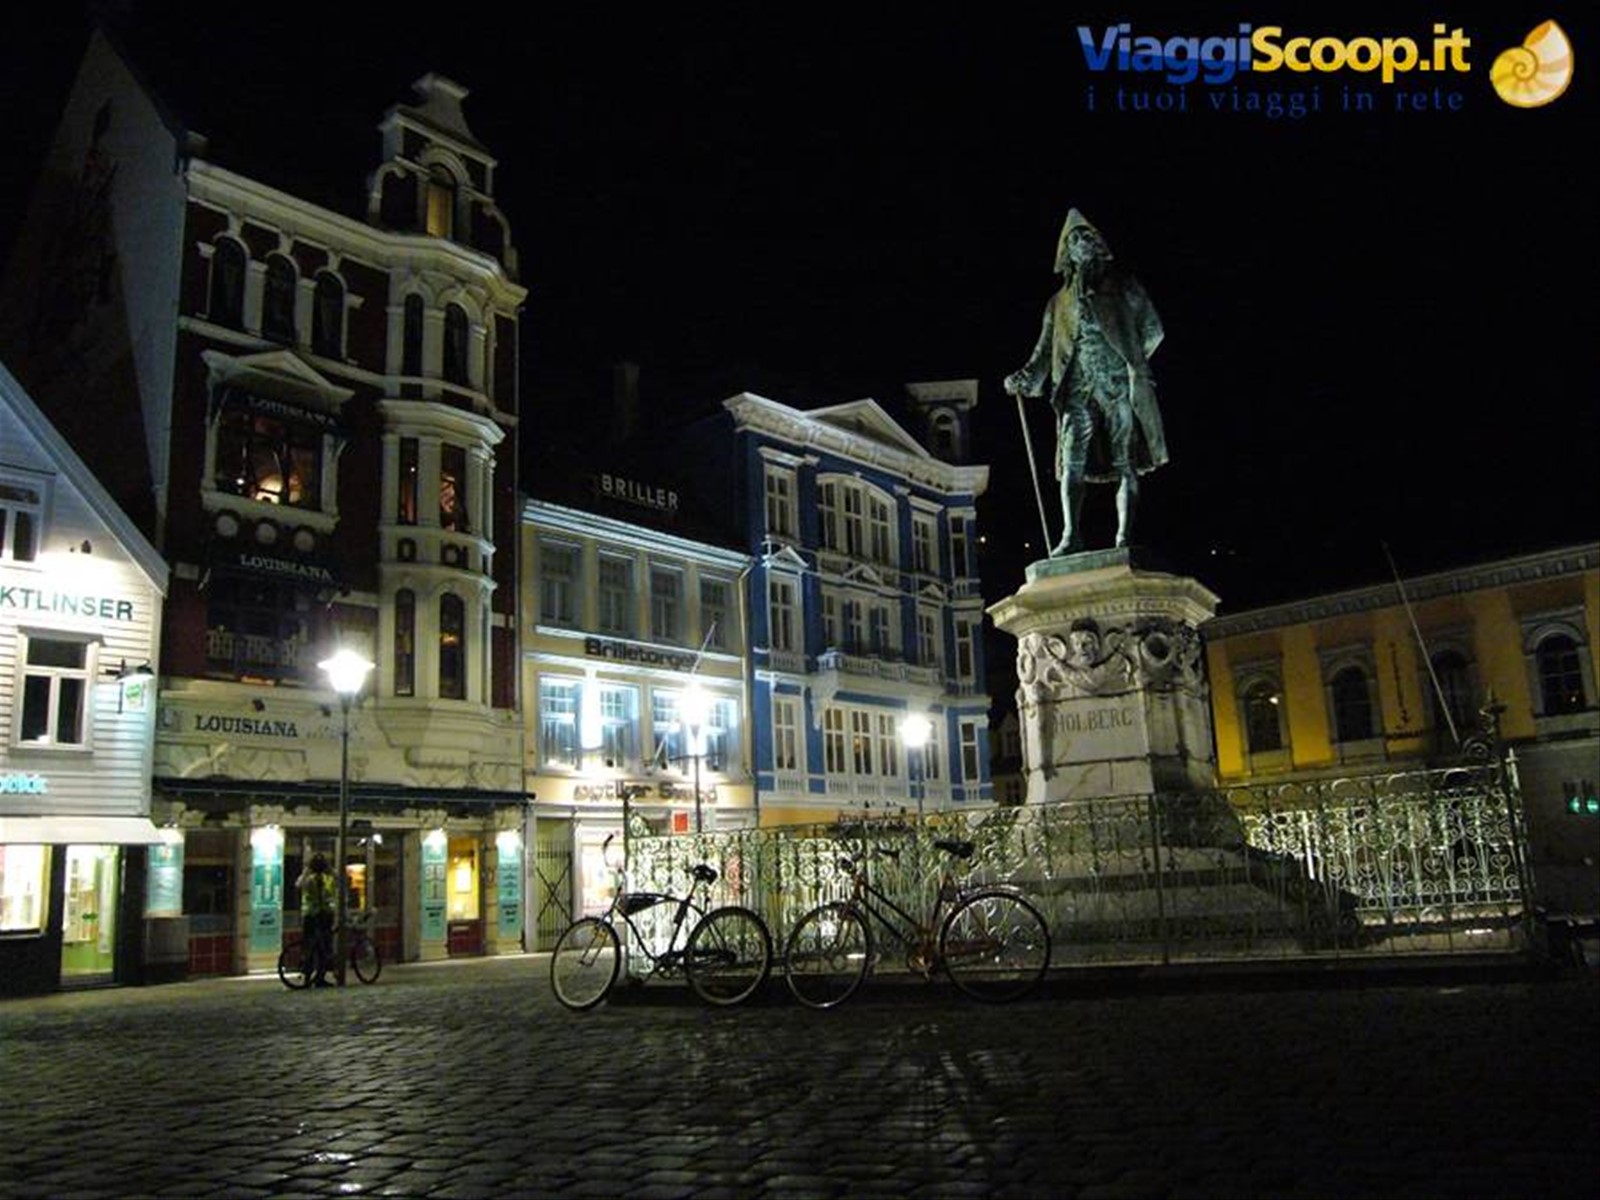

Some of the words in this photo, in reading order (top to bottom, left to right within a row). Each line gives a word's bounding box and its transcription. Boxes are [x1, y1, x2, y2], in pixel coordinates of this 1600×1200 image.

[601, 473, 679, 510] BRILLER
[0, 586, 133, 621] KTLINSER
[195, 714, 298, 738] LOUISIANA
